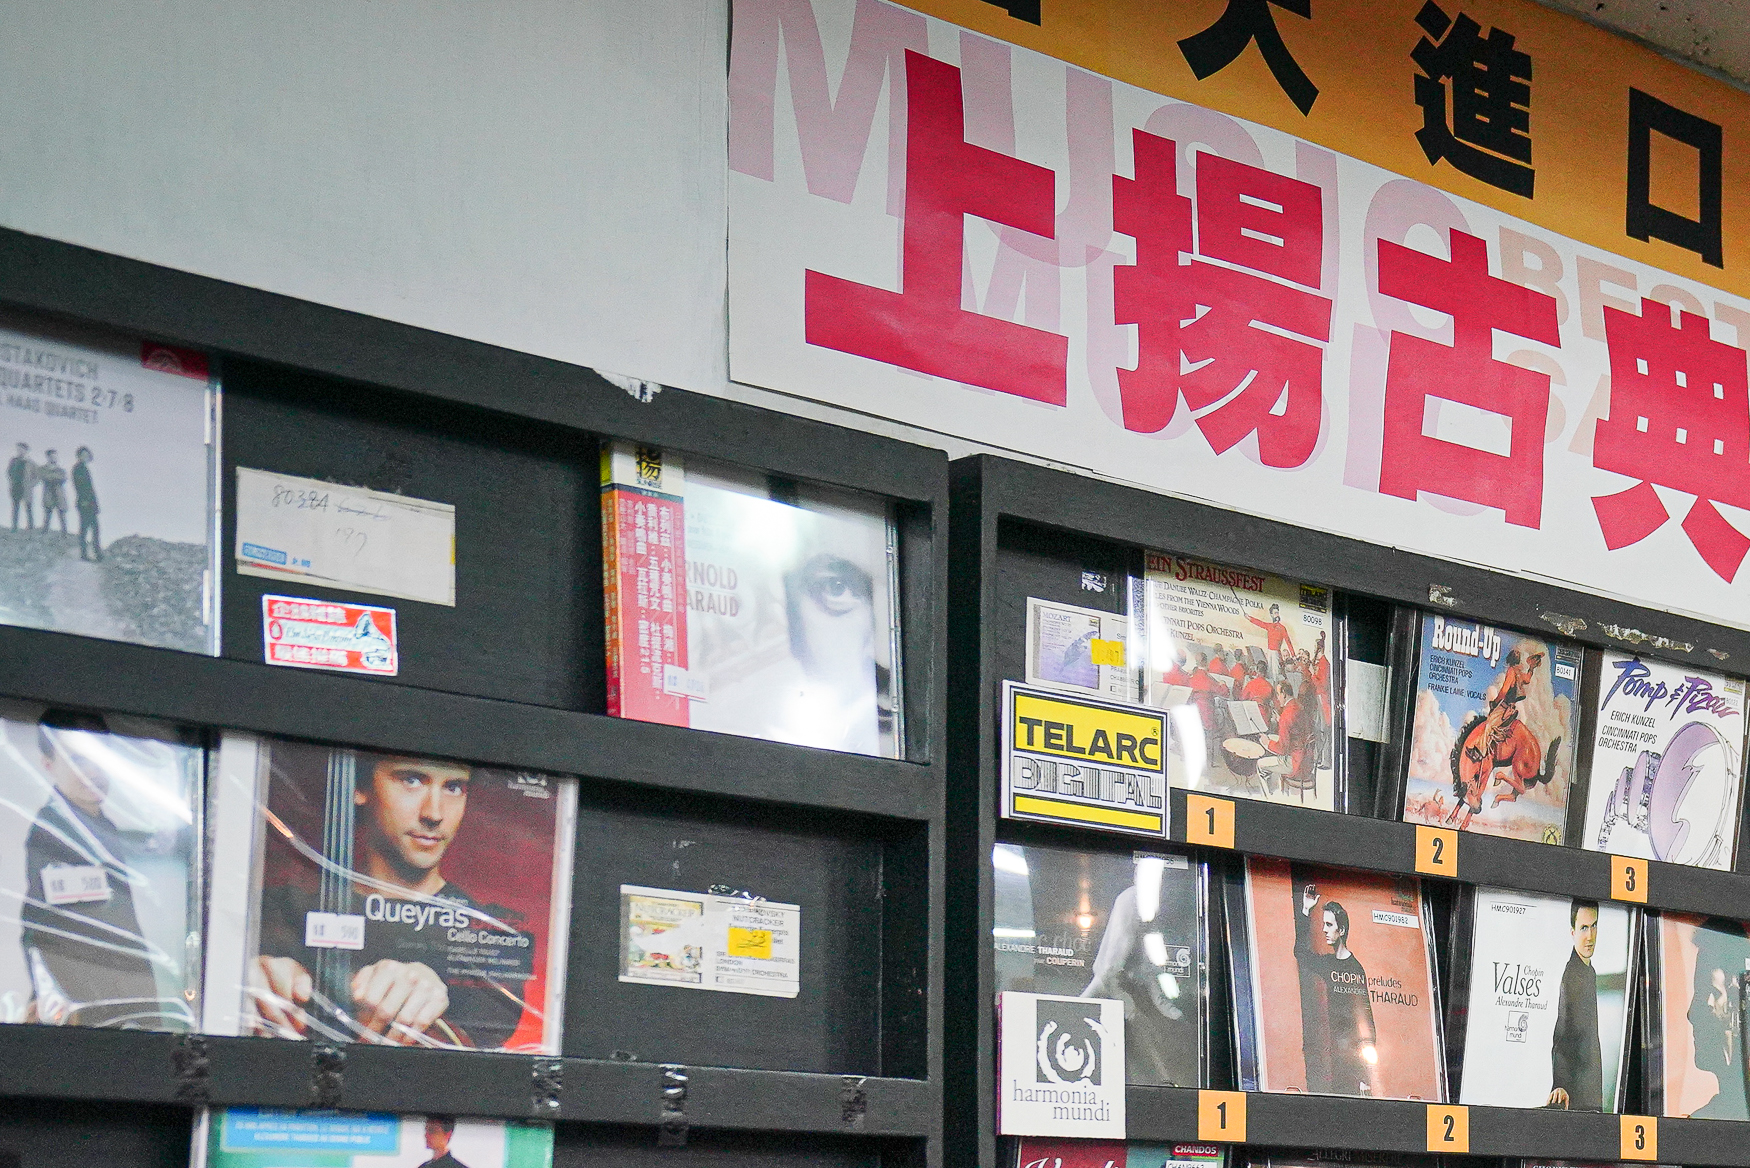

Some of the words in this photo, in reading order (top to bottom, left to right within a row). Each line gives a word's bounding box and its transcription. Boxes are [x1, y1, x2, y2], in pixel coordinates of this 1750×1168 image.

[1175, 558, 1266, 593] STRAUSSFEST
[1195, 599, 1217, 612] VIENNA
[1216, 603, 1240, 615] WOODS
[1206, 624, 1244, 640] ORCHESTRA
[1432, 614, 1501, 667] Round-Up
[1430, 654, 1446, 665] ERICH
[1446, 657, 1465, 669] KUNZEL
[1428, 673, 1459, 685] ORCHESTRA
[1429, 665, 1457, 678] CINCINNATI
[1458, 668, 1473, 679] POPS
[1600, 656, 1668, 713] Pomp
[1610, 710, 1631, 722] ERICH
[1631, 713, 1656, 729] KUNZEL
[1018, 717, 1160, 766] TELARC
[1598, 736, 1638, 754] ORCHESTRA
[1601, 725, 1639, 742] CINCINNATI
[1639, 731, 1658, 745] POPS
[1013, 754, 1162, 808] DIGITAL
[1205, 806, 1216, 835] 1
[1432, 838, 1444, 865] 2
[1625, 866, 1636, 893] 3
[365, 892, 469, 931] Queyras
[1037, 945, 1075, 957] THARAUD
[1045, 956, 1085, 967] COUPERIN
[1523, 965, 1545, 978] Chopin
[1331, 970, 1366, 985] CHOPIN
[1368, 975, 1403, 990] préludes
[1492, 961, 1541, 998] Valses
[1370, 990, 1419, 1007] THARAUD
[1495, 997, 1524, 1009] Alexandre
[1524, 998, 1549, 1011] Tharaud
[1013, 1080, 1097, 1105] harmonia
[1052, 1104, 1111, 1122] mundi
[1217, 1101, 1226, 1129] 1
[1443, 1114, 1455, 1141] 2
[1635, 1125, 1645, 1150] 3
[1174, 1144, 1217, 1155] CHANDOS
